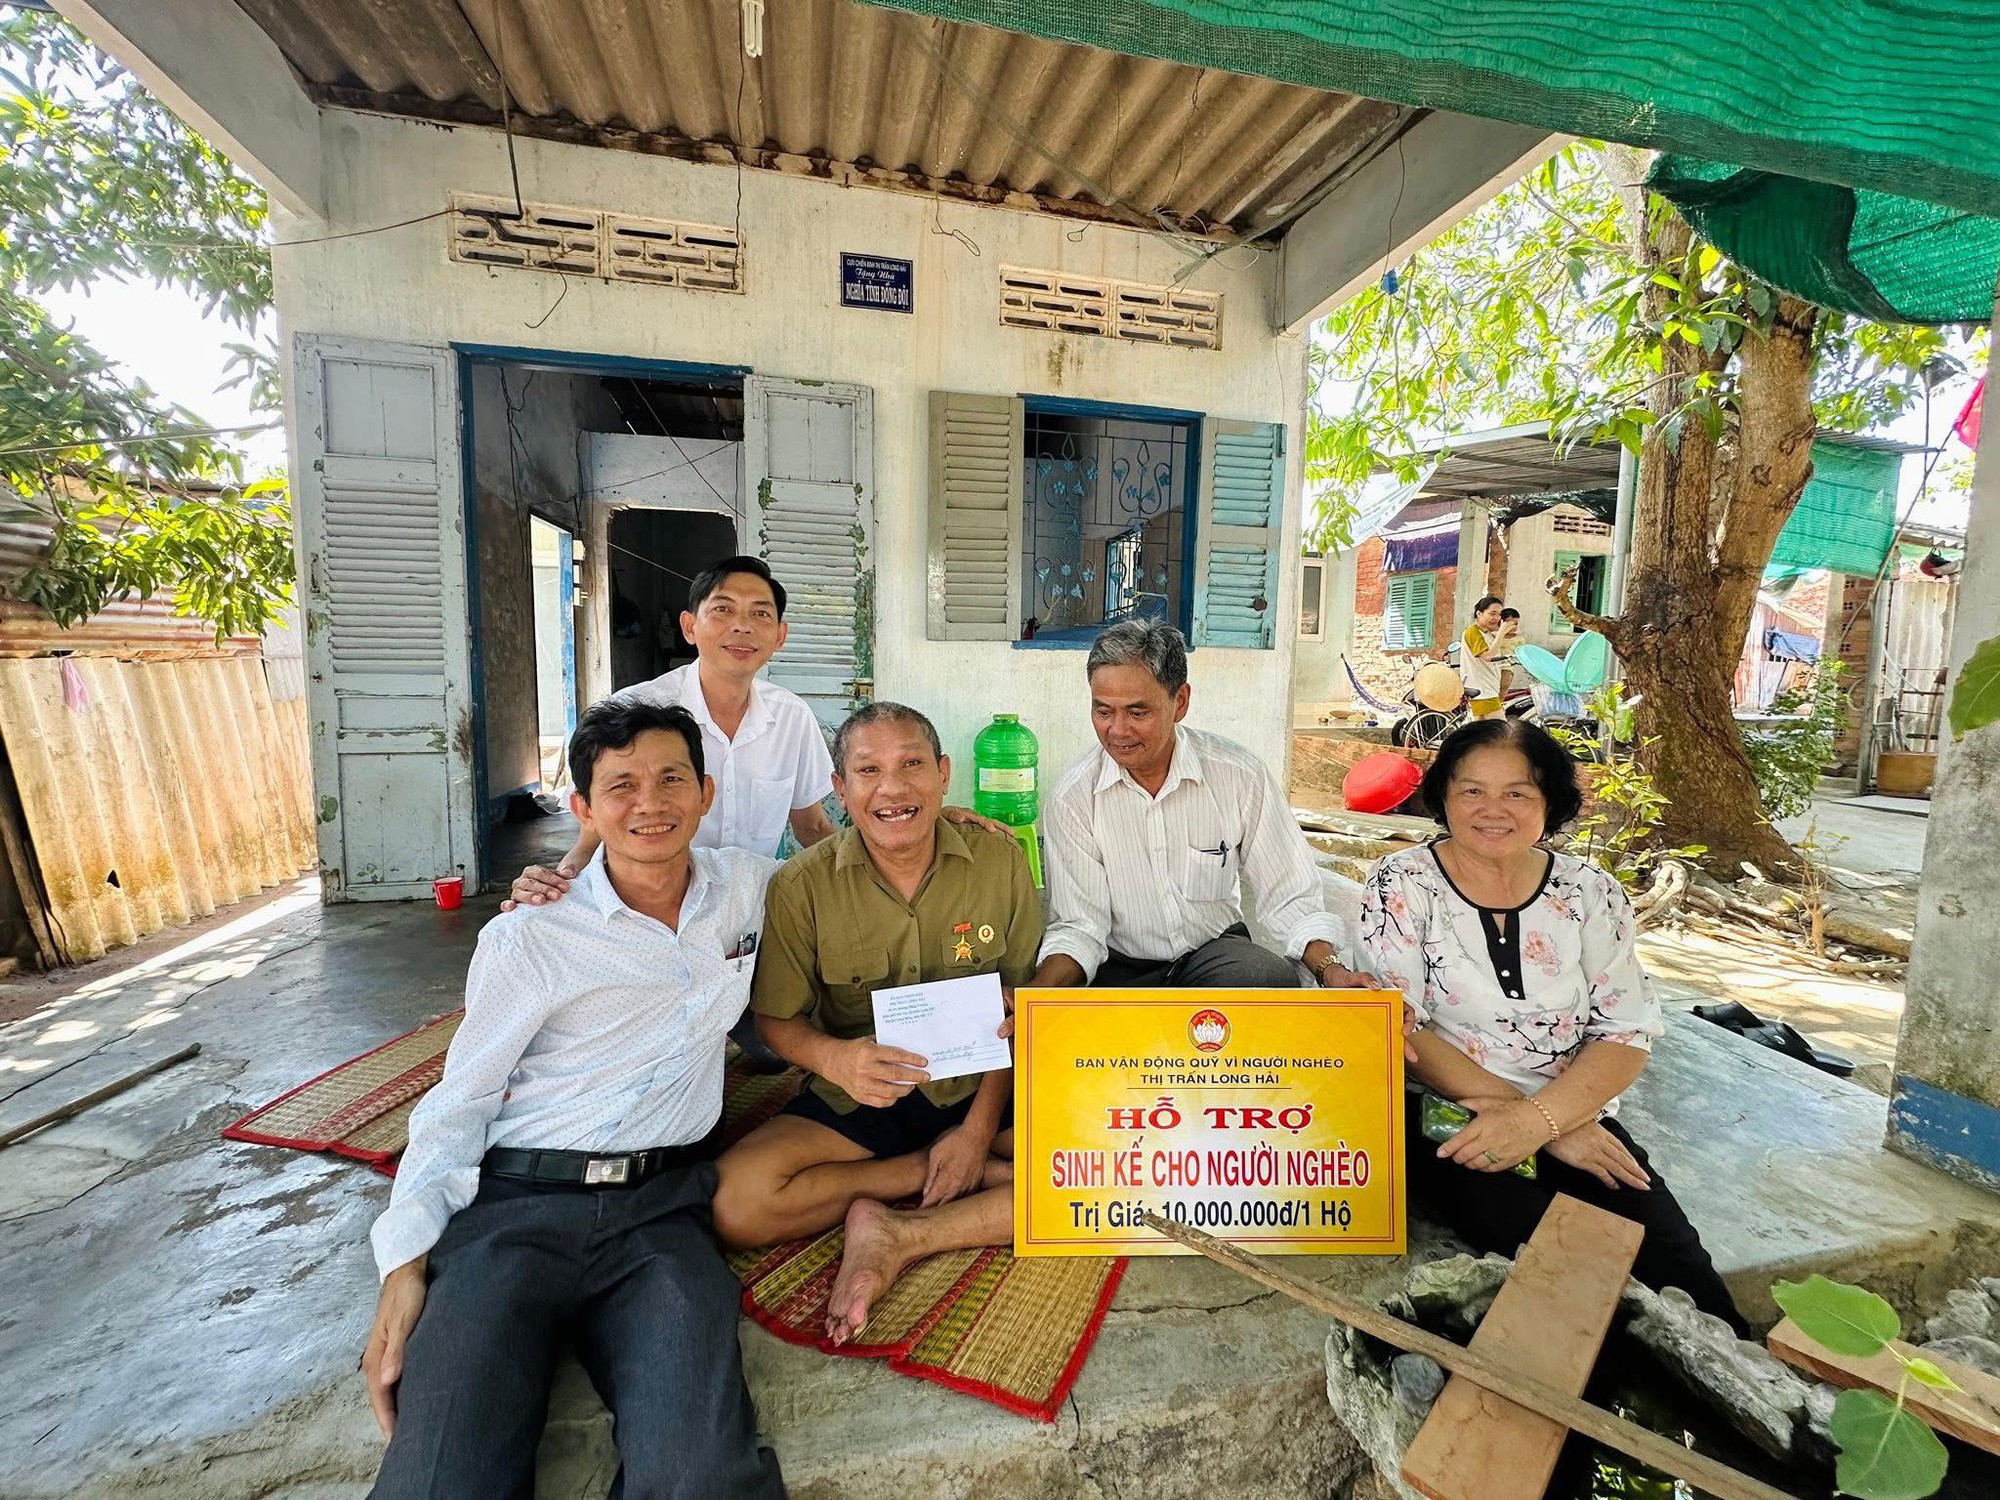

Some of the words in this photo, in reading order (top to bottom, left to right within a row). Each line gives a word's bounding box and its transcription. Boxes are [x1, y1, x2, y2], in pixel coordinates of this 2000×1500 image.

[865, 280, 880, 302] TÌNH
[881, 281, 897, 304] ĐỒNG
[898, 284, 909, 309] ĐỘI
[1075, 1058, 1105, 1068] BAN
[1109, 1056, 1139, 1070] VẬN
[1144, 1056, 1185, 1070] ĐỘNG
[1190, 1056, 1219, 1068] QUỸ
[1224, 1056, 1238, 1068] VÌ
[1242, 1056, 1288, 1068] NGƯỜI
[1292, 1056, 1344, 1069] NGHÈO
[1141, 1074, 1163, 1086] THỊ
[1167, 1071, 1206, 1084] TRẤN
[1211, 1074, 1251, 1084] LONG
[1256, 1071, 1279, 1084] HẢI
[1107, 1096, 1182, 1130] HỖ
[1203, 1104, 1313, 1134] TRỢ
[1052, 1150, 1104, 1187] SINH
[1114, 1136, 1144, 1186] KẾ
[1152, 1150, 1200, 1187] CHO
[1207, 1141, 1278, 1186] NGƯỜI
[1287, 1141, 1369, 1187] NGHÈO
[1070, 1201, 1099, 1233] Trị
[1321, 1200, 1351, 1231] Hộ
